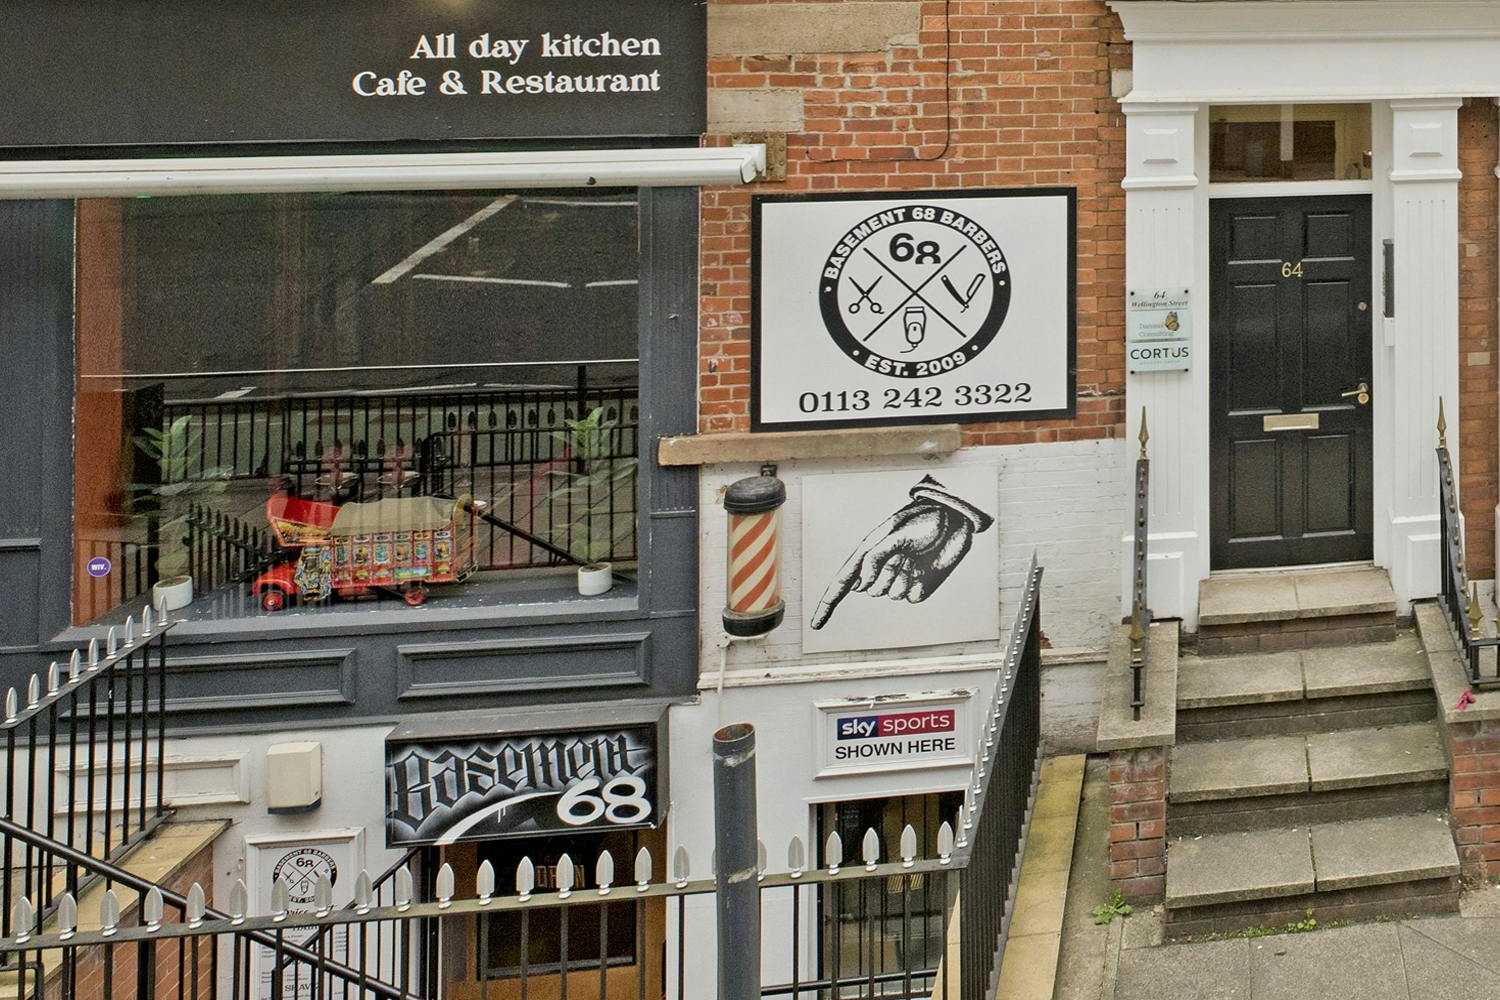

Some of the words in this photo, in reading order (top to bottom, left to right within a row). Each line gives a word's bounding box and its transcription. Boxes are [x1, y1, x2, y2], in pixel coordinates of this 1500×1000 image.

[411, 33, 456, 60] All
[468, 33, 529, 65] day
[541, 32, 662, 58] kitchen
[352, 70, 426, 97] Cafe
[439, 70, 468, 96] &
[480, 69, 661, 96] Restaurant
[825, 208, 906, 280] BASEMENT
[912, 207, 936, 221] 68
[940, 211, 1006, 275] BARBERS
[1282, 262, 1304, 278] 64
[1153, 290, 1166, 299] 64
[864, 353, 909, 377] EST.
[916, 350, 966, 377] 2009
[1130, 347, 1189, 360] CORTUS
[799, 389, 871, 413] 0113
[883, 387, 943, 409] 242
[955, 382, 1032, 406] 3322
[842, 719, 876, 737] sky
[883, 713, 950, 734] sports
[835, 742, 902, 760] SHOWN
[908, 738, 956, 753] HERE
[556, 775, 652, 825] 68
